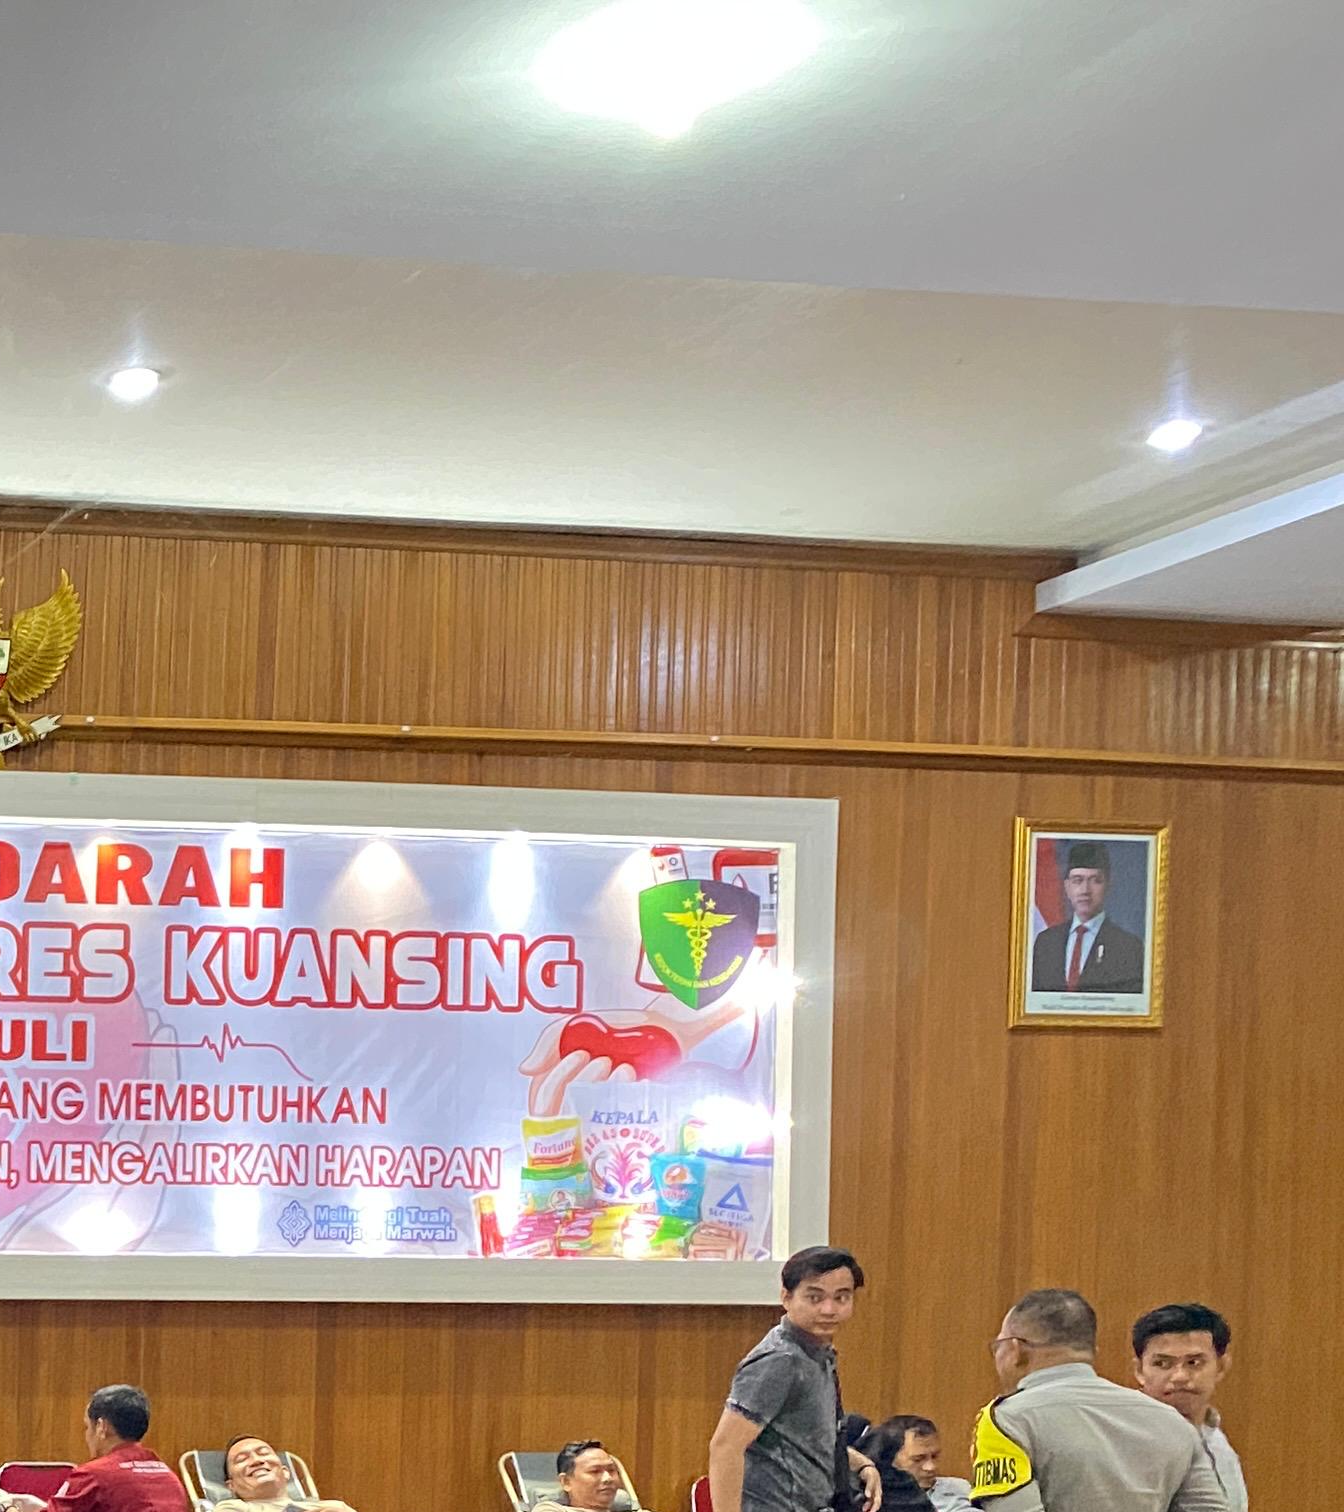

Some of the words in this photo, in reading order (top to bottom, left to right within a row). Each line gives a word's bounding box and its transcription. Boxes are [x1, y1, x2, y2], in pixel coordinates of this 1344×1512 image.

[3, 734, 20, 749] IKA
[165, 927, 584, 1012] KUANSING
[98, 1083, 388, 1124] MEMBUTUHKAN
[591, 1110, 659, 1125] KEPALA
[28, 1141, 308, 1185] MENGALIRKAN
[316, 1145, 501, 1189] HARAPAN
[407, 1207, 452, 1223] Tuah
[386, 1226, 457, 1241] Marwah
[974, 1457, 1017, 1487] TIBMAS
